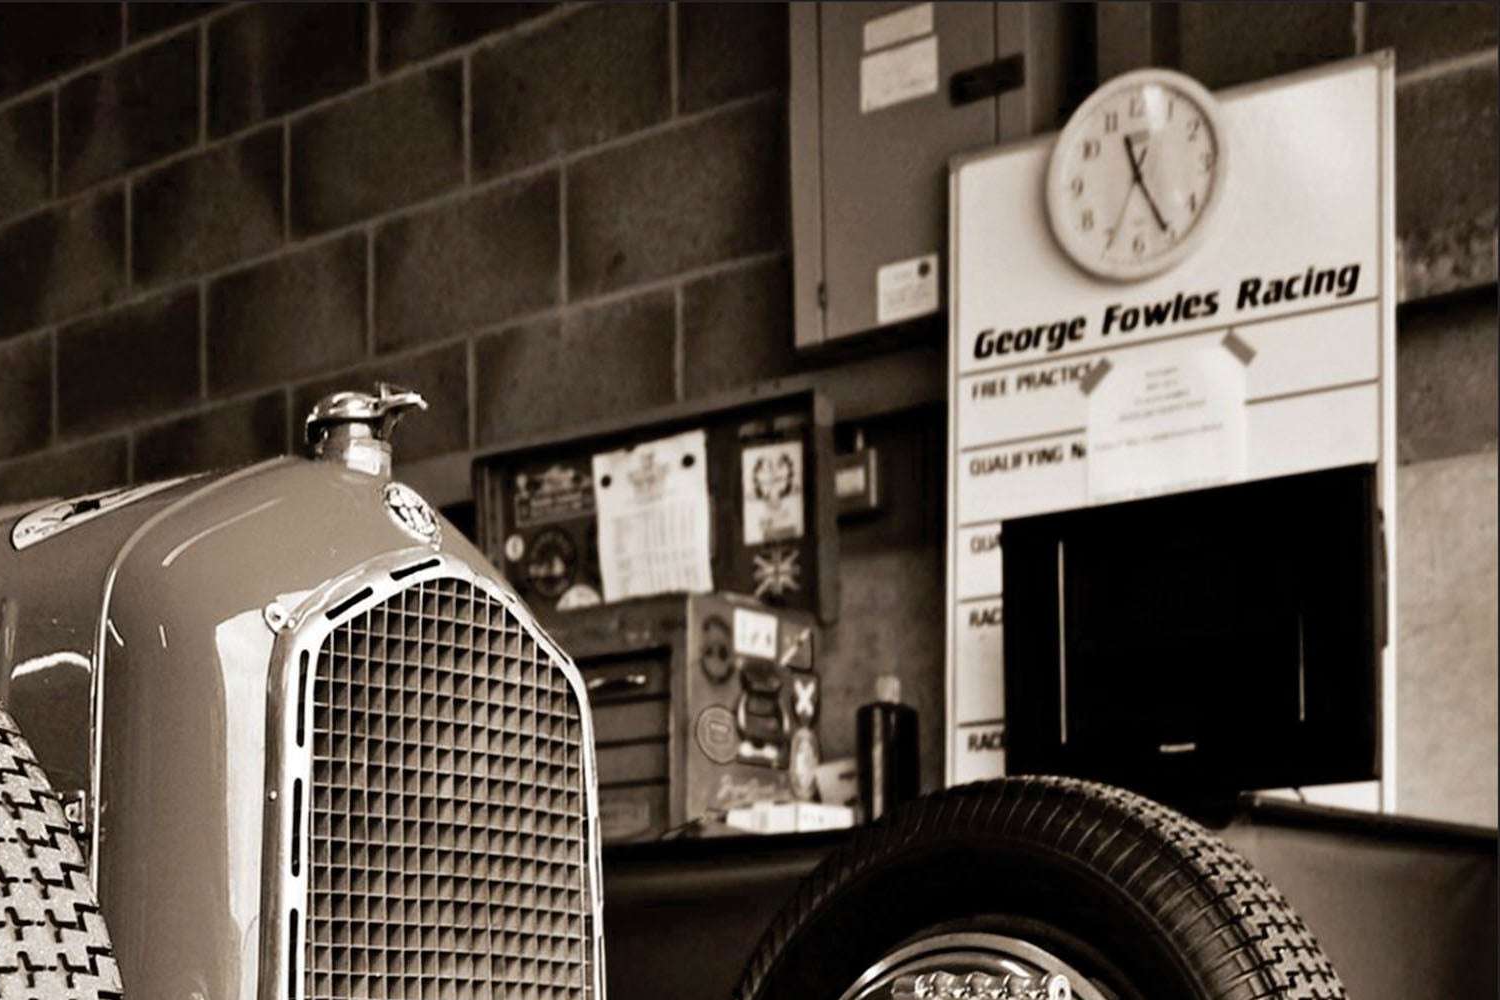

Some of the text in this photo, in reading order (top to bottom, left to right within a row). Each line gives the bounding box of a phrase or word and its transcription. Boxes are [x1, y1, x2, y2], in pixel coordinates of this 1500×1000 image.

[1104, 111, 1119, 134] 11
[1083, 139, 1102, 161] 10
[1071, 178, 1085, 199] 9
[1081, 210, 1095, 232] 8
[1131, 236, 1146, 255] 6
[973, 263, 1361, 360] George Fowles Racing
[971, 377, 1006, 400] FREE
[969, 444, 1064, 476] QUALIFYING
[967, 732, 1004, 752] RAC
